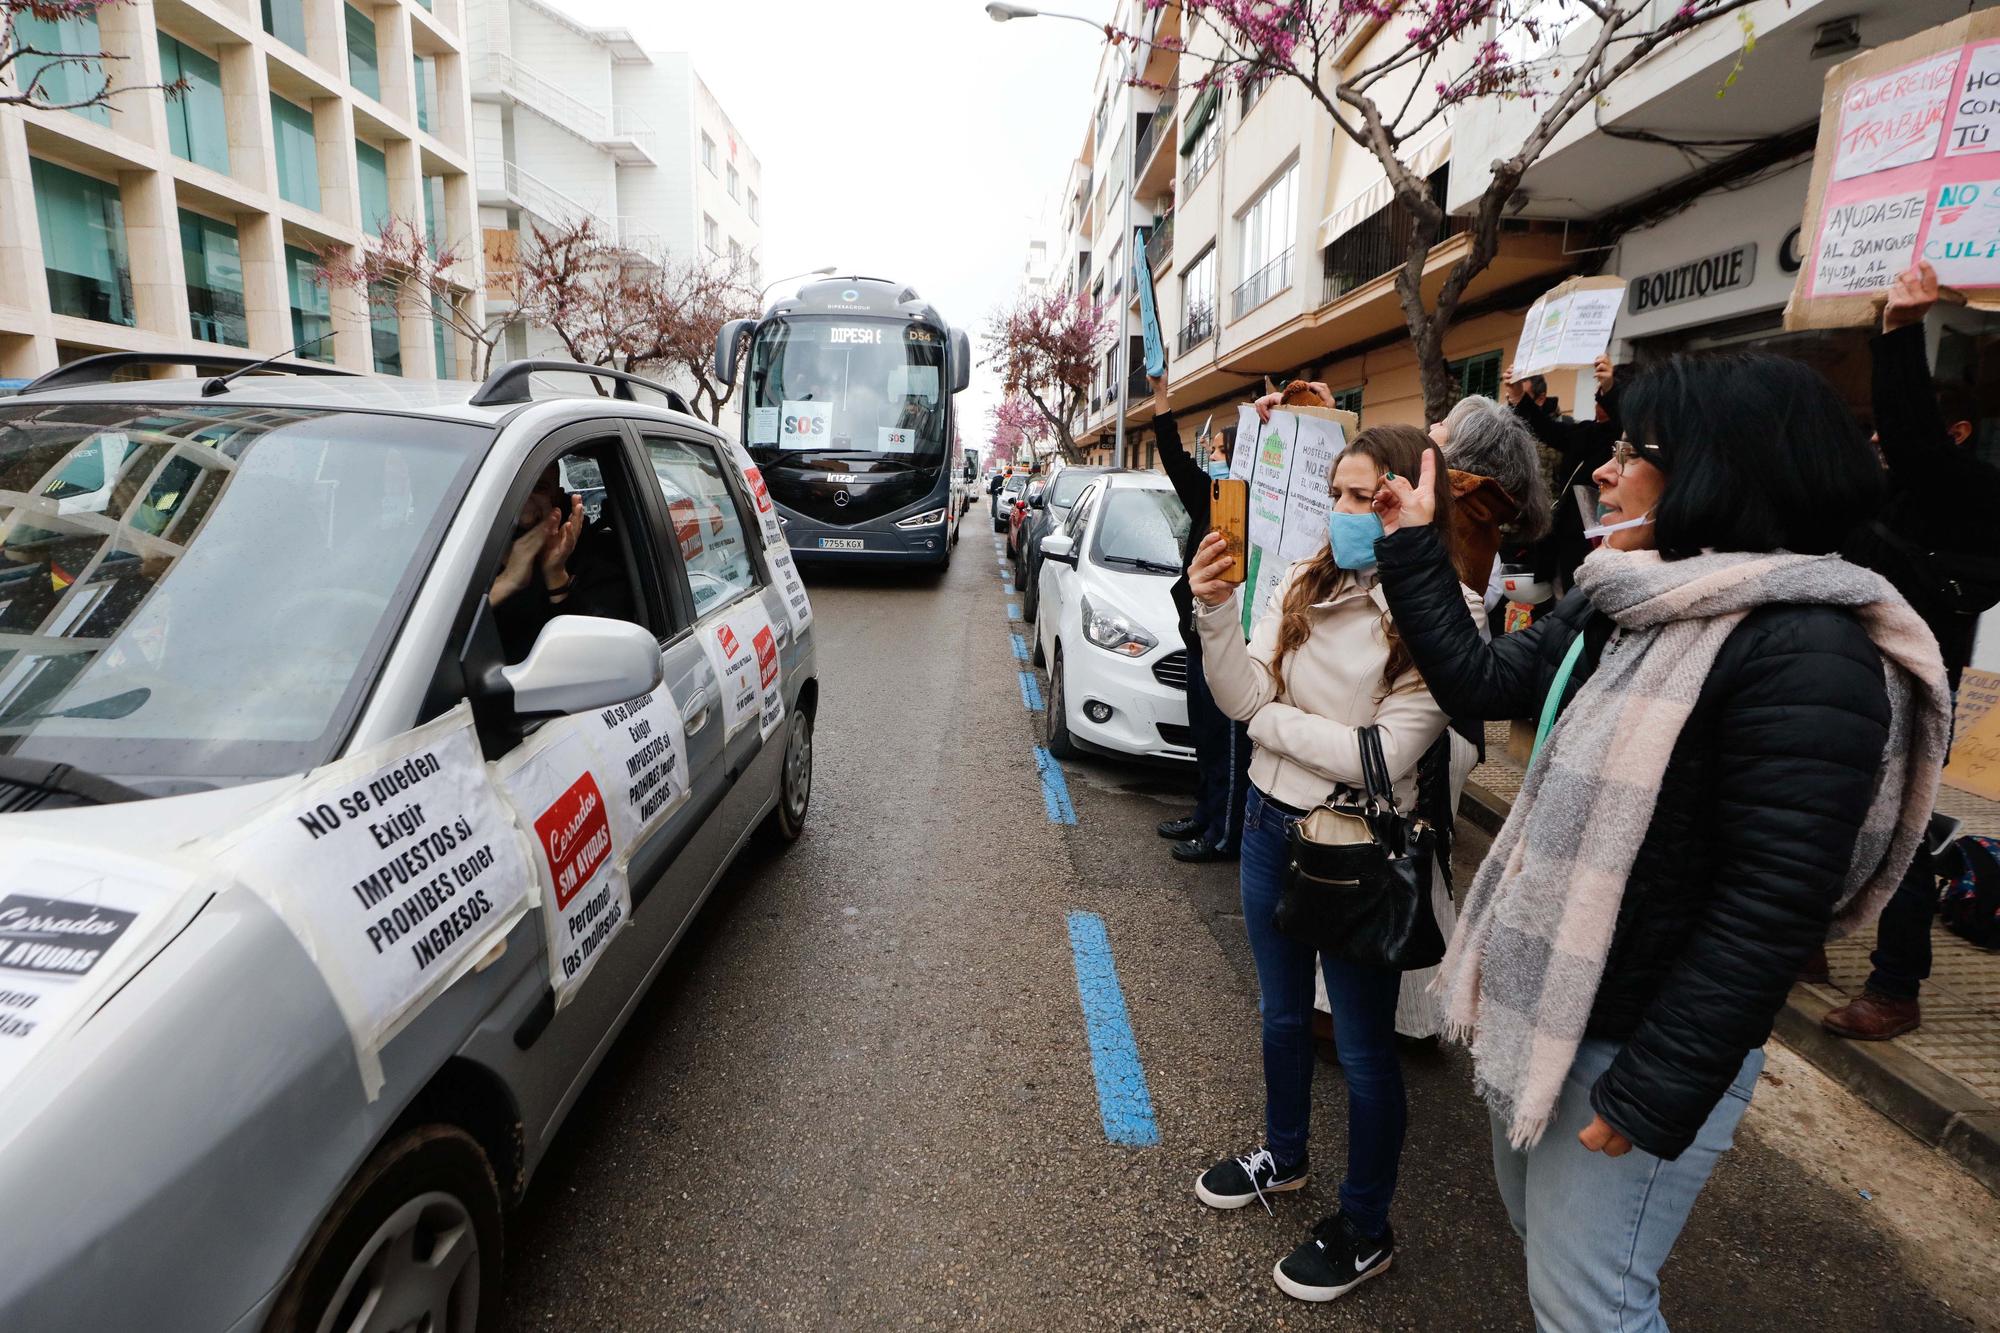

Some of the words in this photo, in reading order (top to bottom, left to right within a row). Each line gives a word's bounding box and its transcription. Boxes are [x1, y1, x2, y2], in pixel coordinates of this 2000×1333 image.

[1848, 60, 1958, 112] QUEREMOS
[1829, 196, 1925, 237] AYUDASTE
[1938, 184, 1980, 208] NO
[1818, 265, 1857, 285] AYUDA
[1865, 260, 1887, 275] AL
[1823, 244, 1843, 260] AL
[1636, 250, 1744, 310] BOUTIQUE
[830, 328, 874, 344] DIPESA
[909, 331, 931, 342] D54
[784, 415, 825, 434] SOS
[888, 433, 905, 443] SOS
[827, 473, 857, 483] Irizar
[1305, 460, 1317, 474] NO
[824, 539, 845, 548] 7755
[846, 539, 862, 548] KGX
[601, 709, 618, 730] NO
[615, 705, 628, 722] se
[628, 718, 652, 743] Exigir
[626, 736, 664, 778] IMPUESTOS
[297, 804, 341, 840] NO
[339, 790, 370, 820] se
[369, 752, 441, 807] pueden
[629, 765, 661, 806] PROHIBES
[368, 803, 427, 850] Exigir
[550, 791, 597, 863] Cerrados
[352, 825, 457, 911] IMPUESTOS
[454, 814, 473, 842] si
[559, 862, 578, 897] SIN
[577, 824, 609, 883] AYUDAS
[365, 872, 457, 955] PROHIBES
[449, 844, 495, 887] tener
[568, 883, 611, 941] Perdonen
[411, 889, 495, 971] INGRESOS.
[561, 949, 582, 980] las
[582, 899, 622, 961] molestias
[3, 942, 100, 971] AYUDAS
